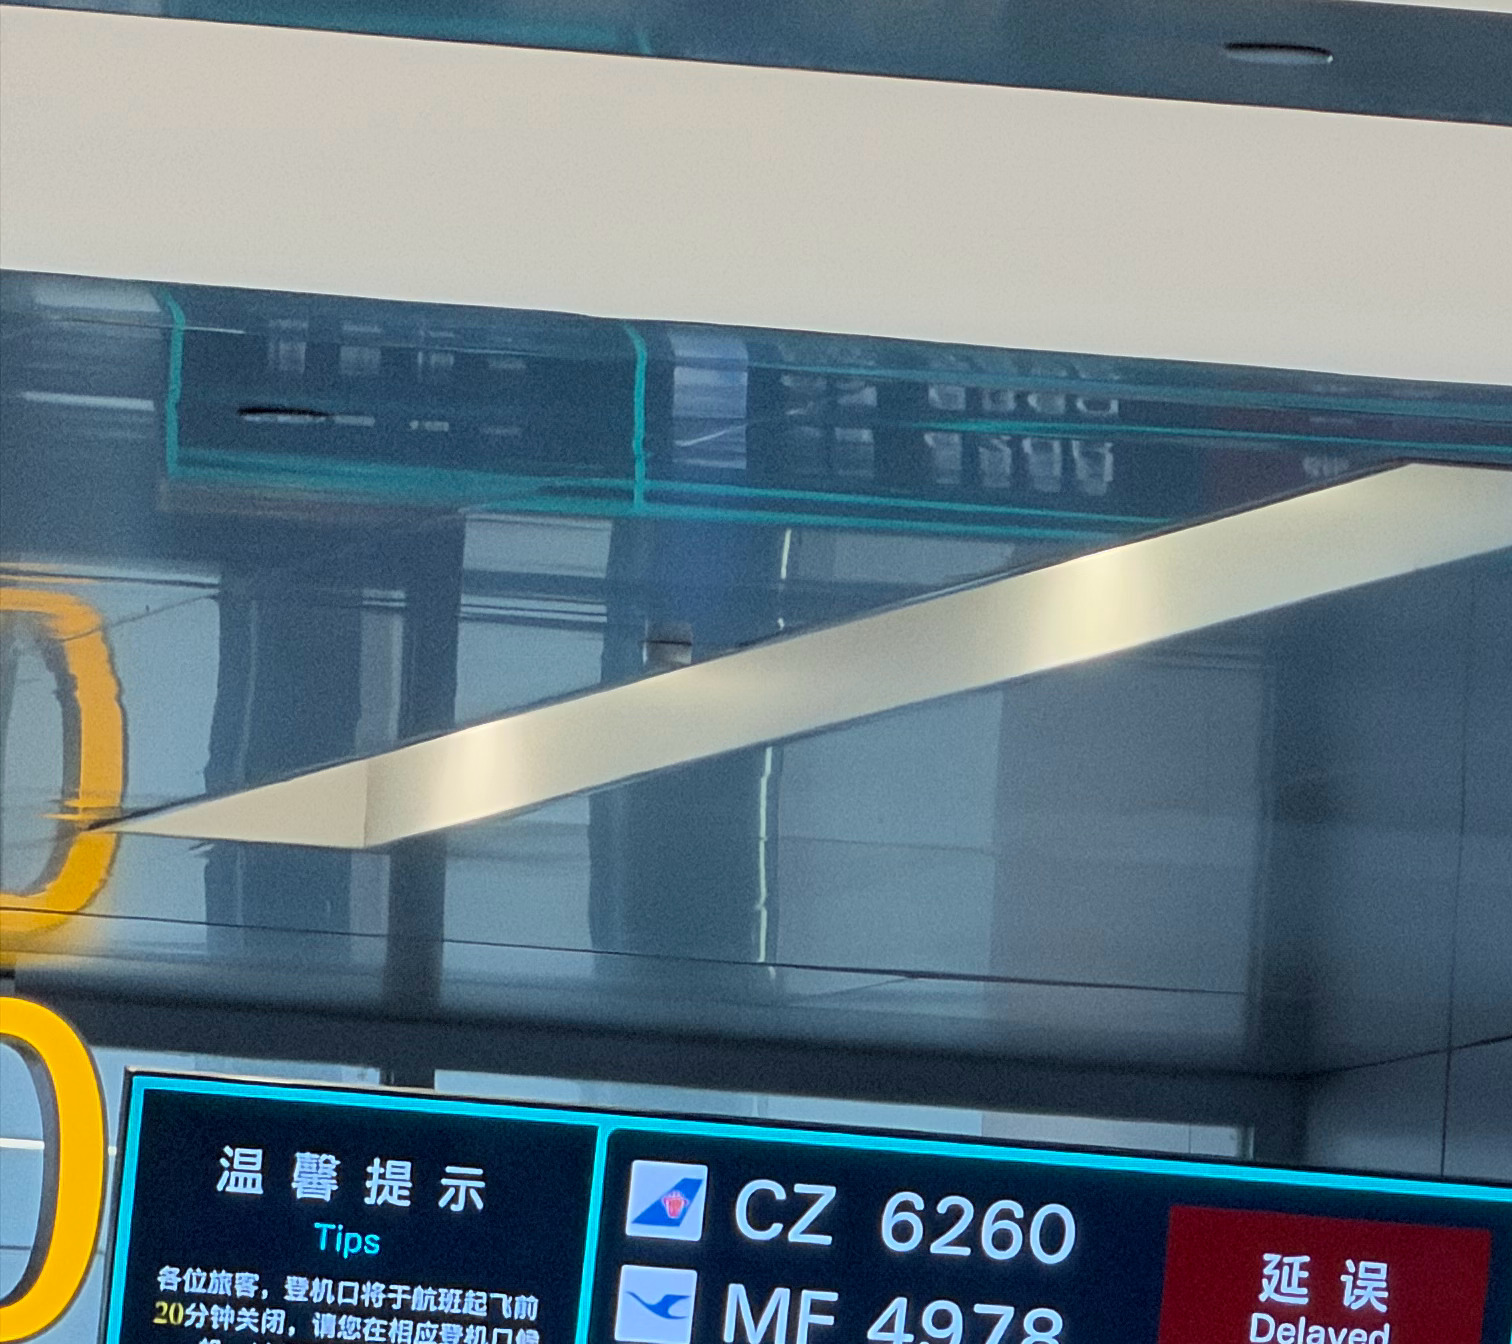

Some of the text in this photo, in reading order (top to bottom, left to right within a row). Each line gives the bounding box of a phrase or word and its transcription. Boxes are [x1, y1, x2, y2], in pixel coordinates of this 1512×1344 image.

[216, 1146, 486, 1212] 温馨提示
[314, 1222, 380, 1257] Tips
[734, 1178, 1078, 1266] CZ 6260
[157, 1265, 539, 1321] 各位旅客，登机口将于航班起飞前
[1257, 1252, 1390, 1315] 延误
